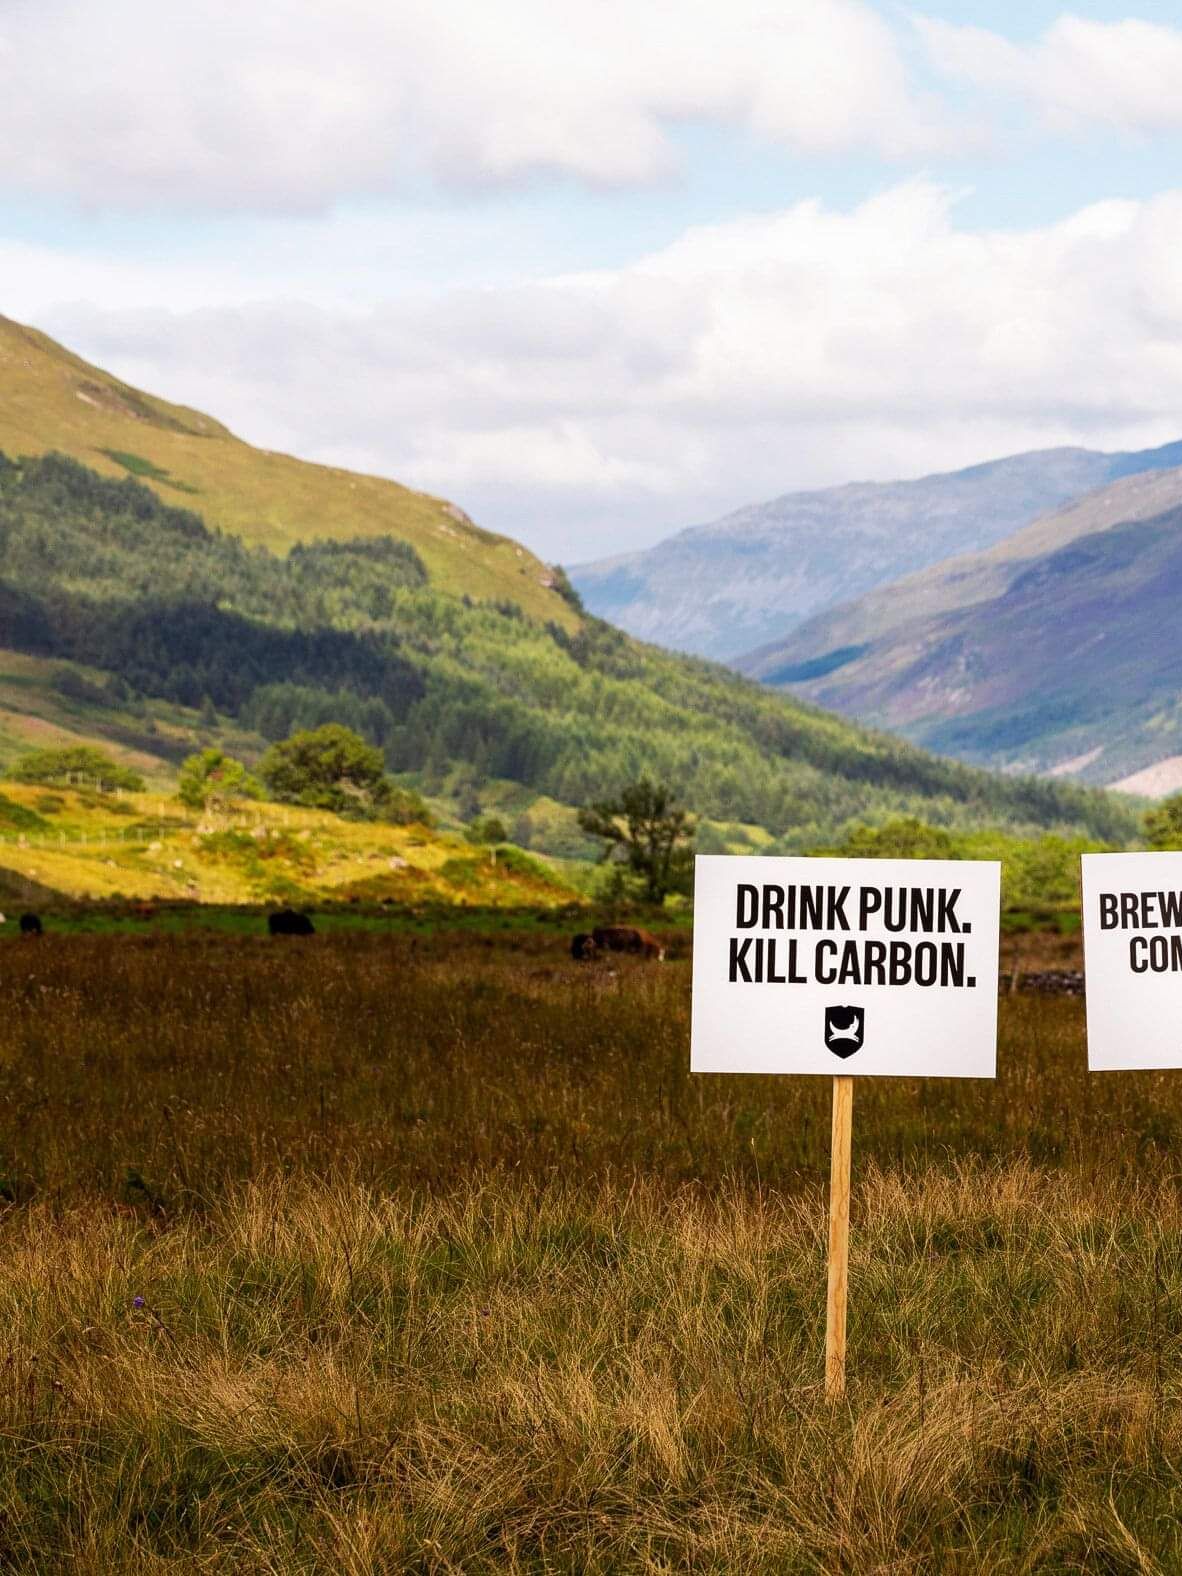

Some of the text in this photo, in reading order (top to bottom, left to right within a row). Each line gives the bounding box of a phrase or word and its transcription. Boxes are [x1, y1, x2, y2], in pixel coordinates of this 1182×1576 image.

[736, 883, 972, 934] DRINK PUNK.
[728, 937, 977, 988] KILL CARBON.
